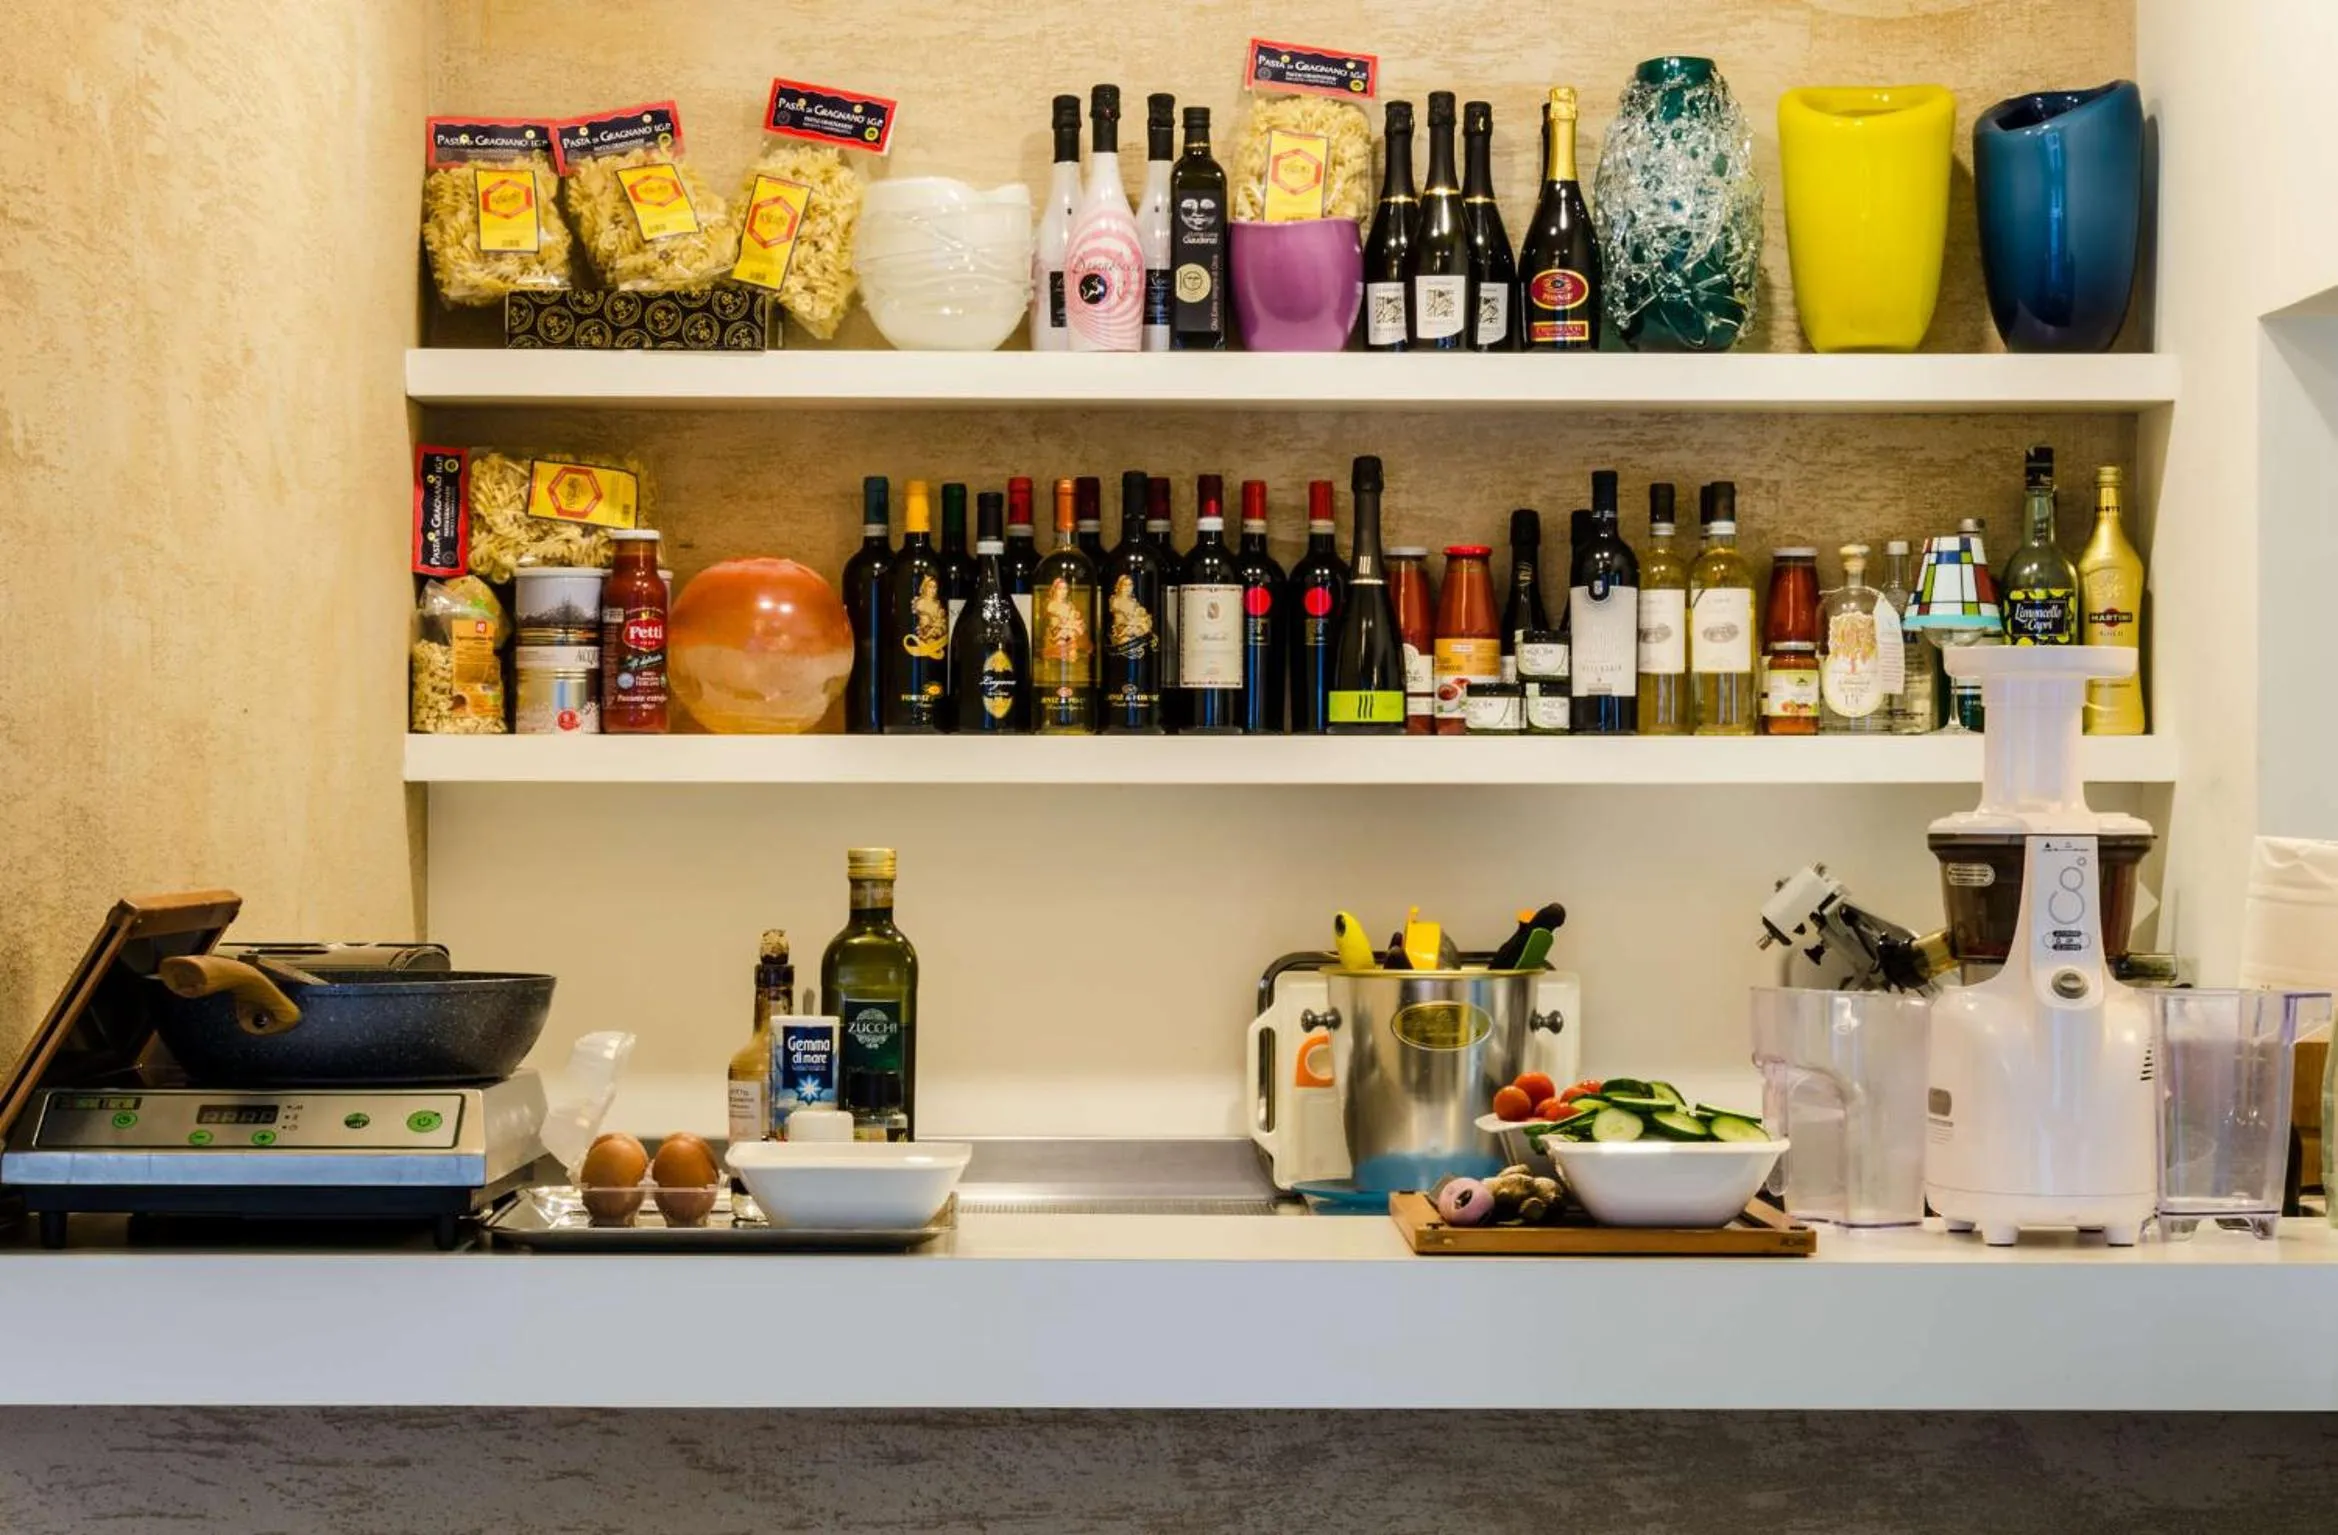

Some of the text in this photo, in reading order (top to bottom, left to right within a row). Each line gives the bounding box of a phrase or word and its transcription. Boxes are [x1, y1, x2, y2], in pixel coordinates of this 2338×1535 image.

[2090, 614, 2131, 622] MARTINI
[629, 625, 662, 640] Petti
[847, 1021, 898, 1034] ZUCCHI
[787, 1035, 830, 1051] Gemma
[792, 1051, 827, 1064] di mare
